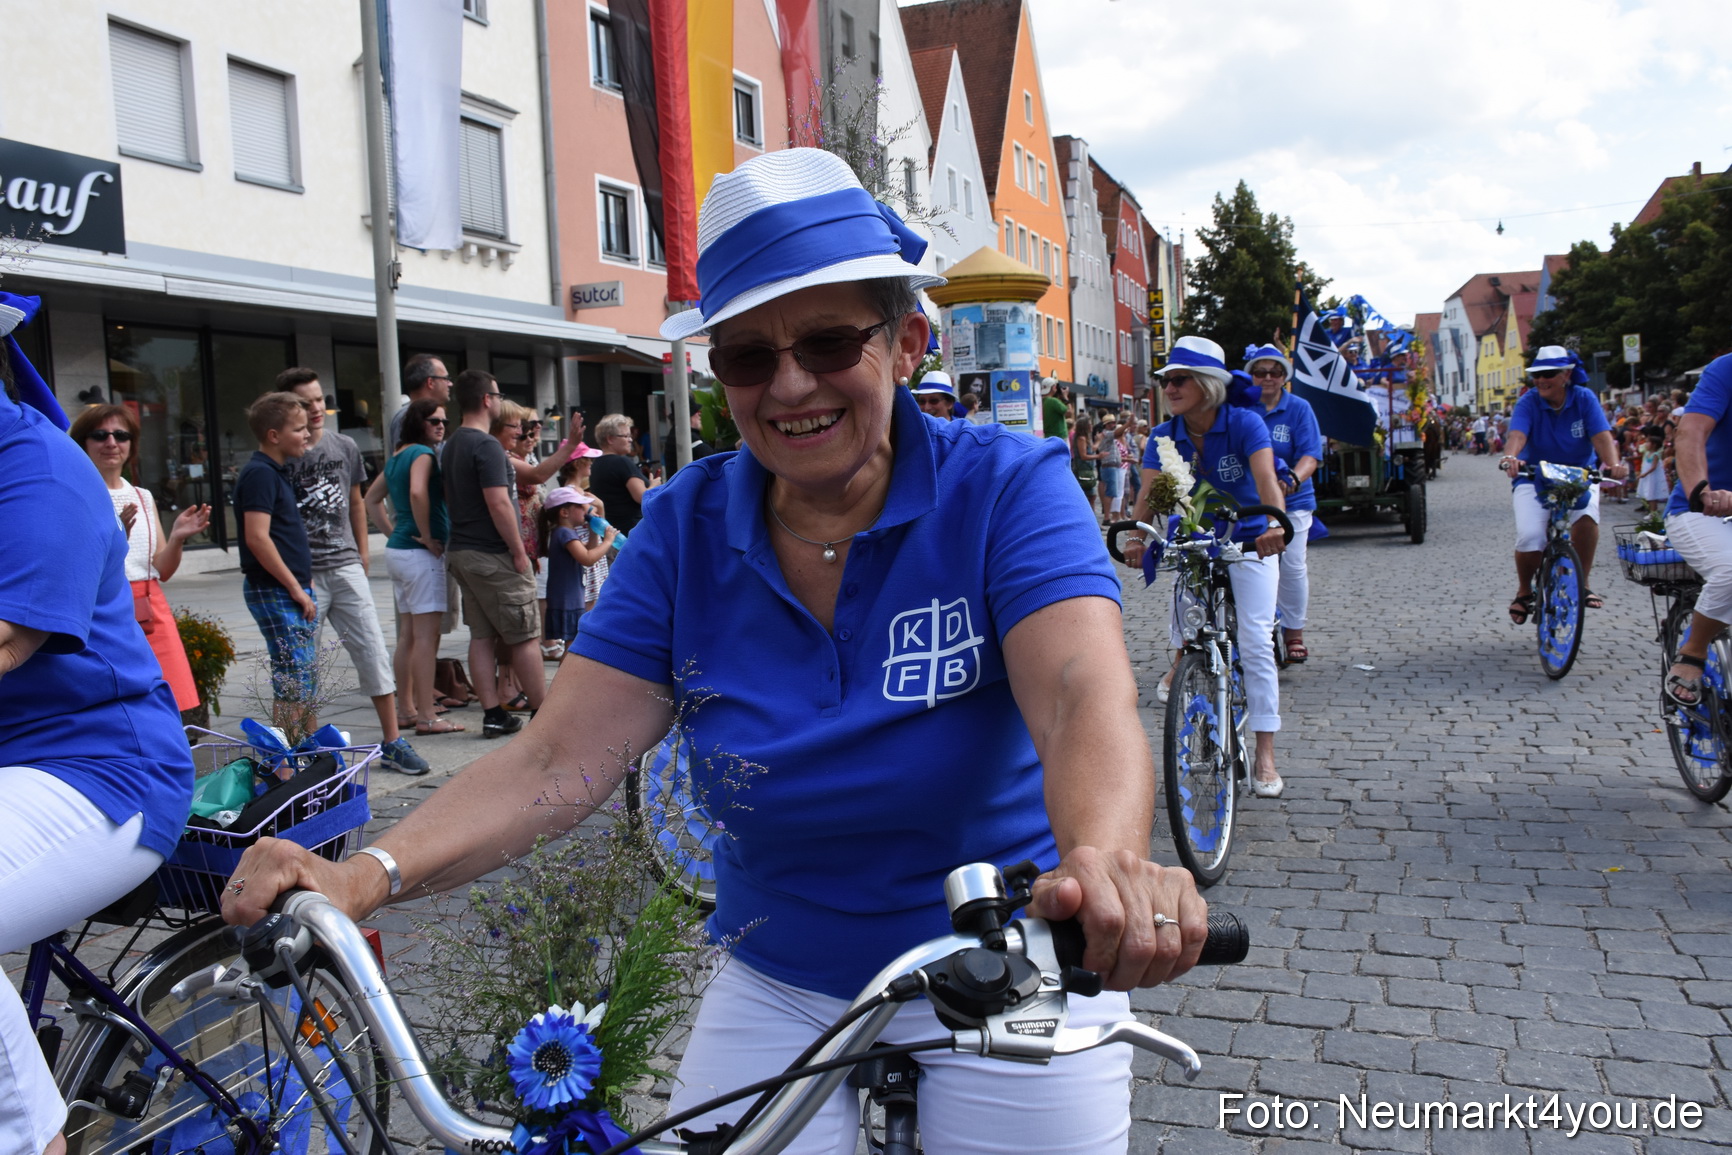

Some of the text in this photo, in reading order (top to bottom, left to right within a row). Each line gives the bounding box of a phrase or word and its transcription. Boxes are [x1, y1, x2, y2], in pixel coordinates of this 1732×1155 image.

[0, 171, 114, 235] auf
[572, 287, 618, 304] sutor.
[1149, 291, 1166, 368] HOTEL
[1011, 1020, 1056, 1030] SHIMANO
